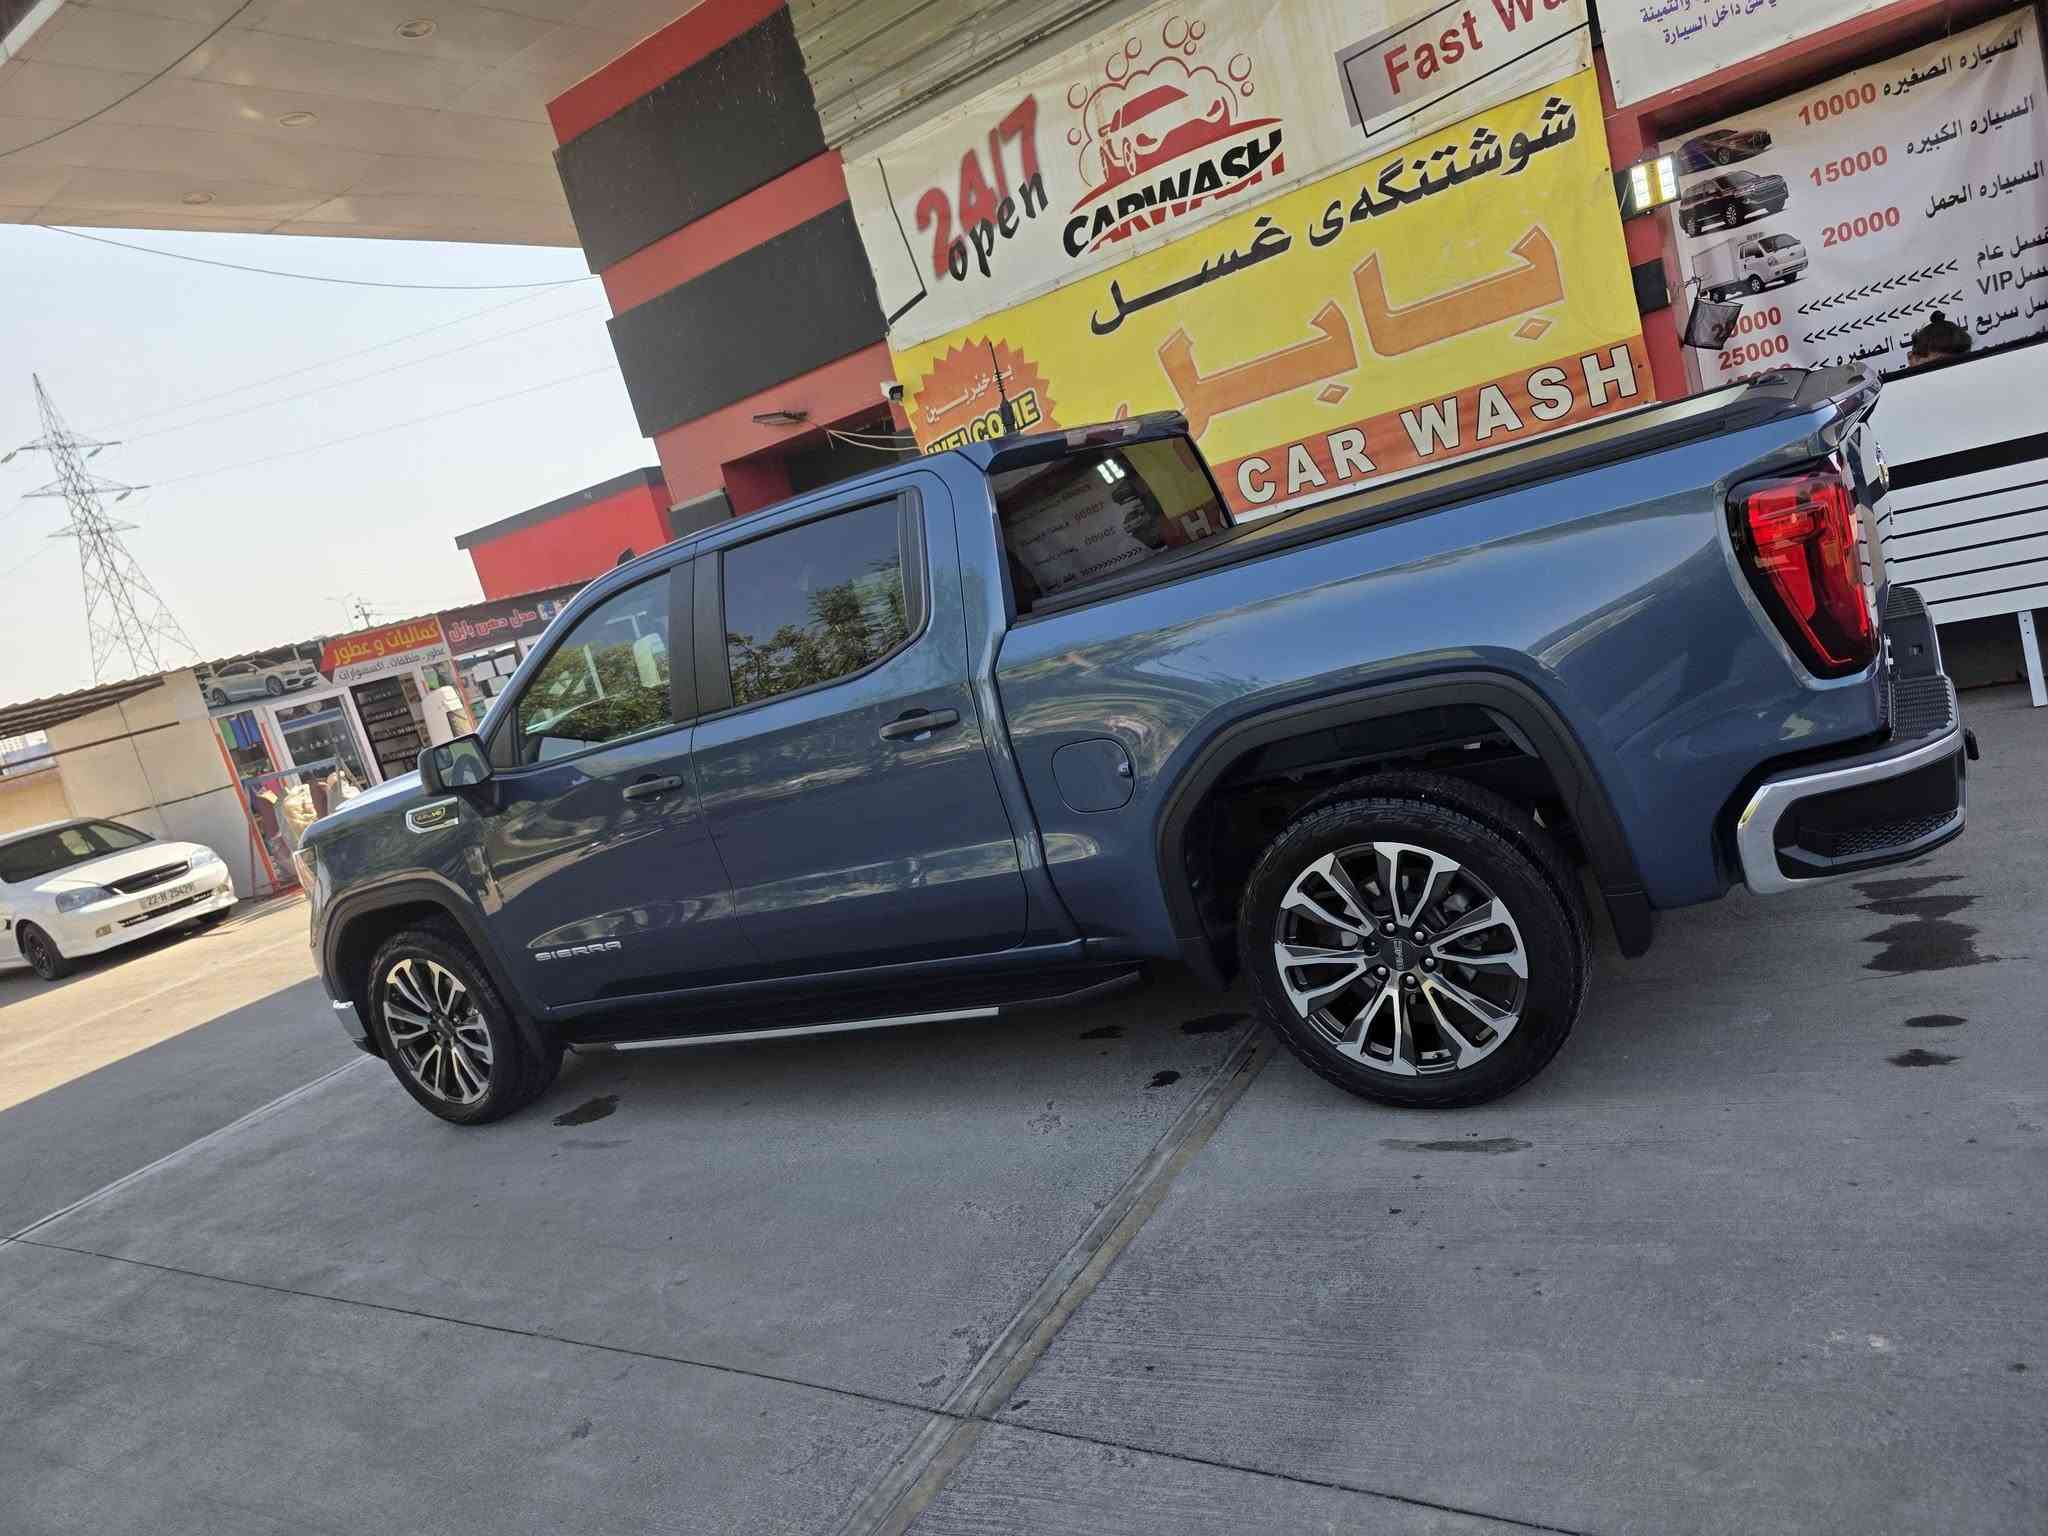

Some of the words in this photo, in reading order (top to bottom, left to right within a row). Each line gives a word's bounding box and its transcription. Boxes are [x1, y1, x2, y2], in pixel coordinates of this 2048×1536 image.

[1384, 9, 1484, 95] Fast
[1664, 17, 1708, 45] السيارة
[1798, 82, 1877, 126] 10000
[915, 92, 1038, 281] 24/7
[1809, 144, 1888, 188] 15000
[1062, 127, 1285, 258] CARWASH
[949, 171, 1049, 282] open
[1822, 205, 1901, 248] 20000
[1090, 216, 1292, 336] غسل
[1976, 270, 2013, 295] VIP
[1717, 334, 1789, 371] 25000
[1235, 426, 1378, 506] CAR
[1400, 342, 1641, 458] WASH
[535, 940, 622, 962] SIERRA
